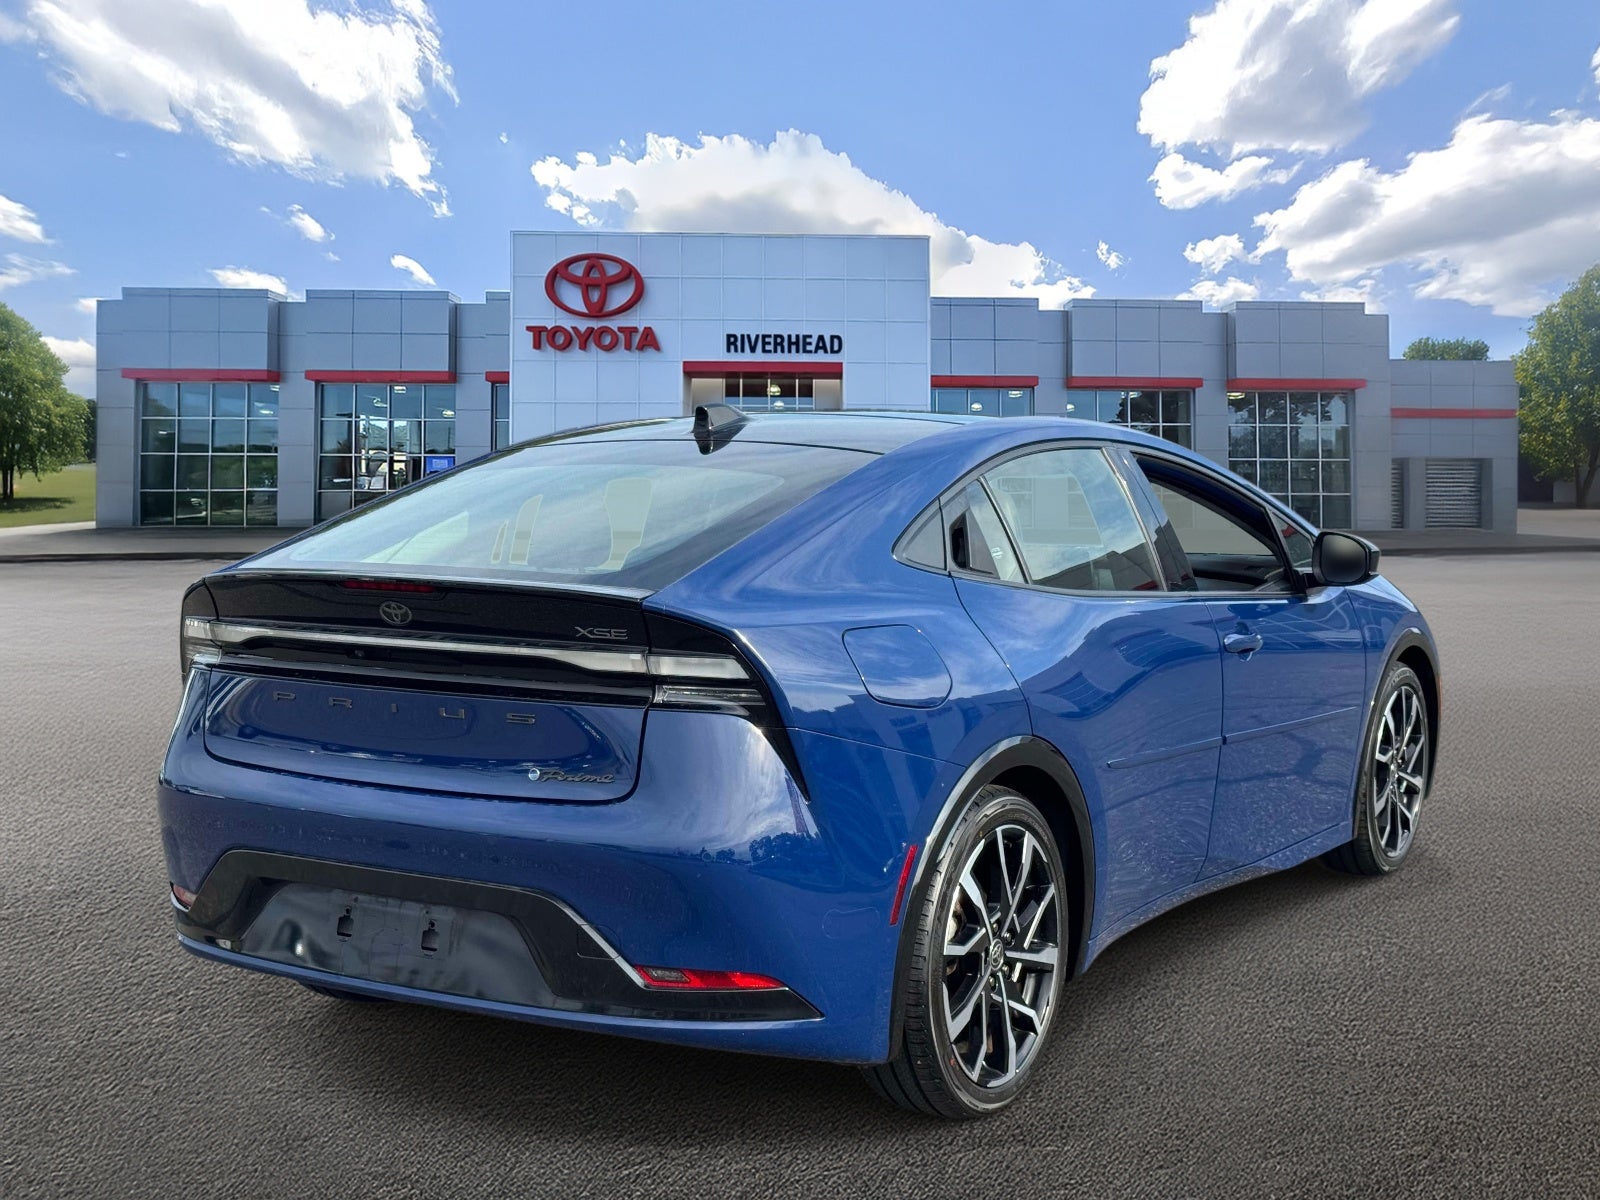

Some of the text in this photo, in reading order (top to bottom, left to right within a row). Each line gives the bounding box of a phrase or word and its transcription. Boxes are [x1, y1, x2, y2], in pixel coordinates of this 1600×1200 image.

[526, 325, 661, 351] TOYOTA
[726, 333, 843, 354] RIVERHEAD
[574, 626, 628, 640] XSE
[273, 691, 535, 724] PRIUS
